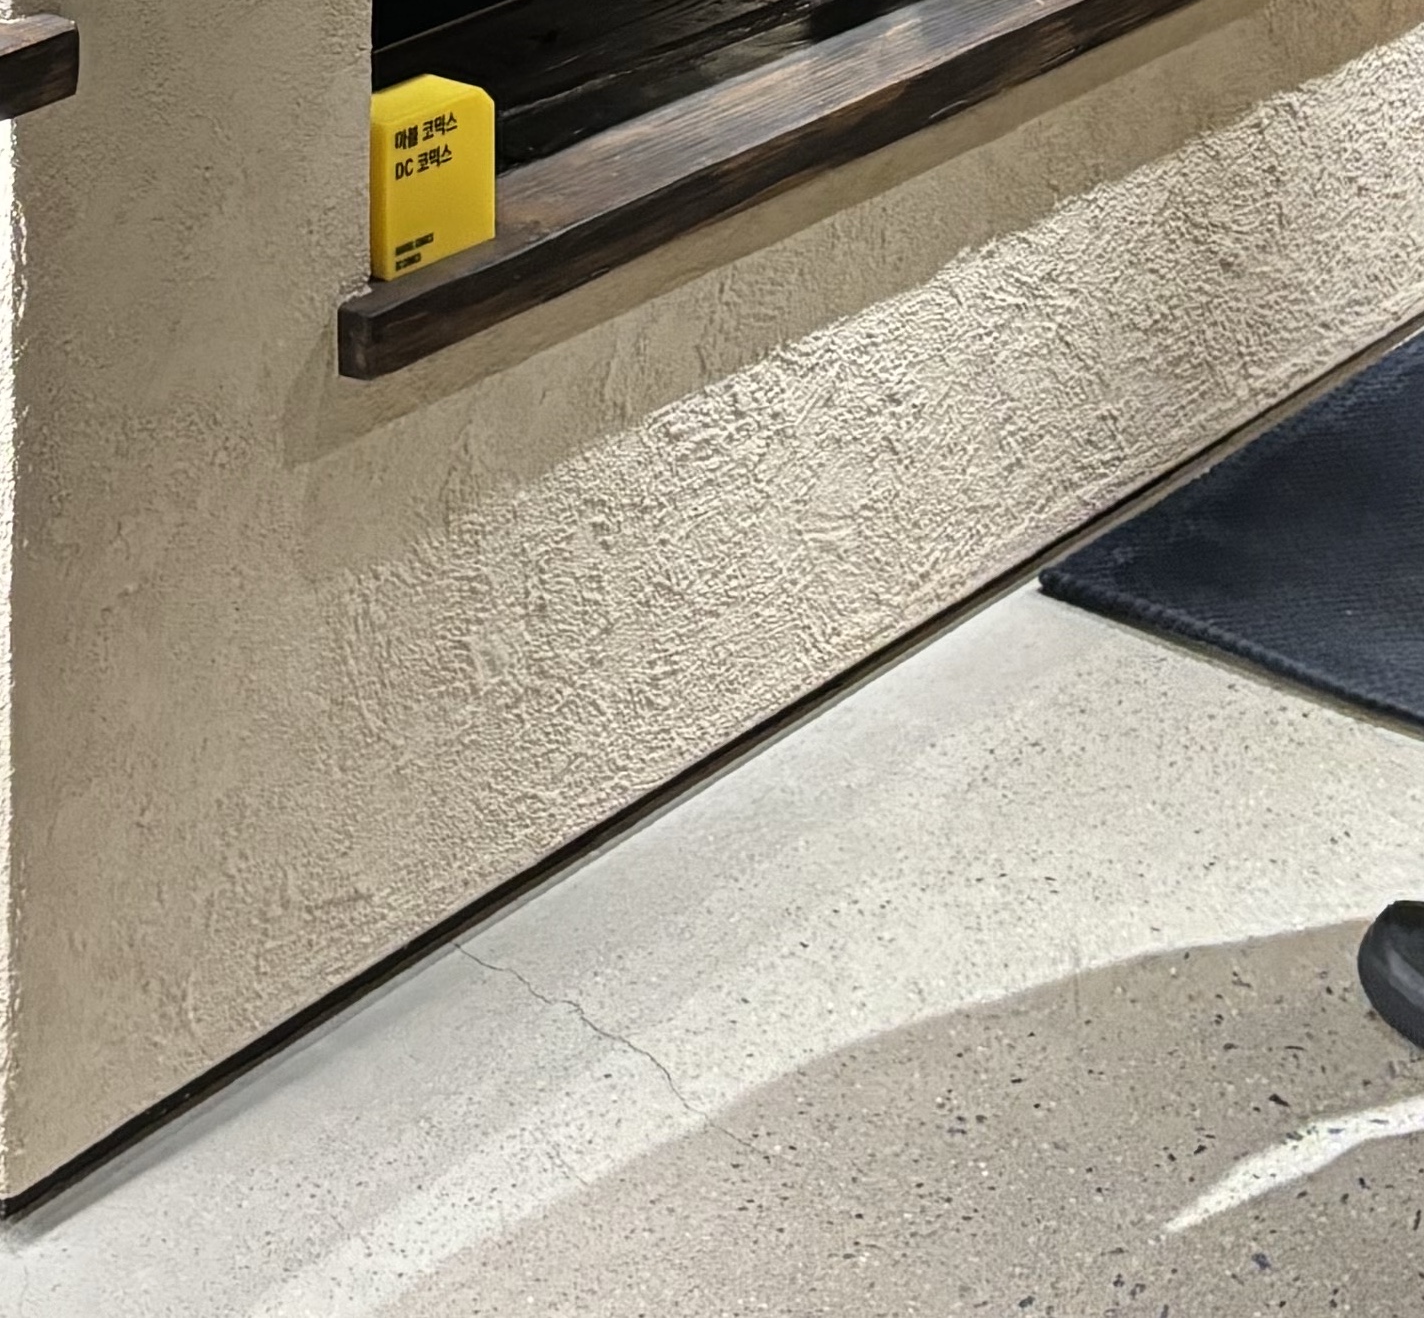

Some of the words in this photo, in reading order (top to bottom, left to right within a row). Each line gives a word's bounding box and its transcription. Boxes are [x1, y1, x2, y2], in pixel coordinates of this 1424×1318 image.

[395, 125, 419, 150] 마블
[422, 111, 458, 142] 코믹스
[395, 157, 414, 181] DC
[417, 143, 453, 173] 코믹스
